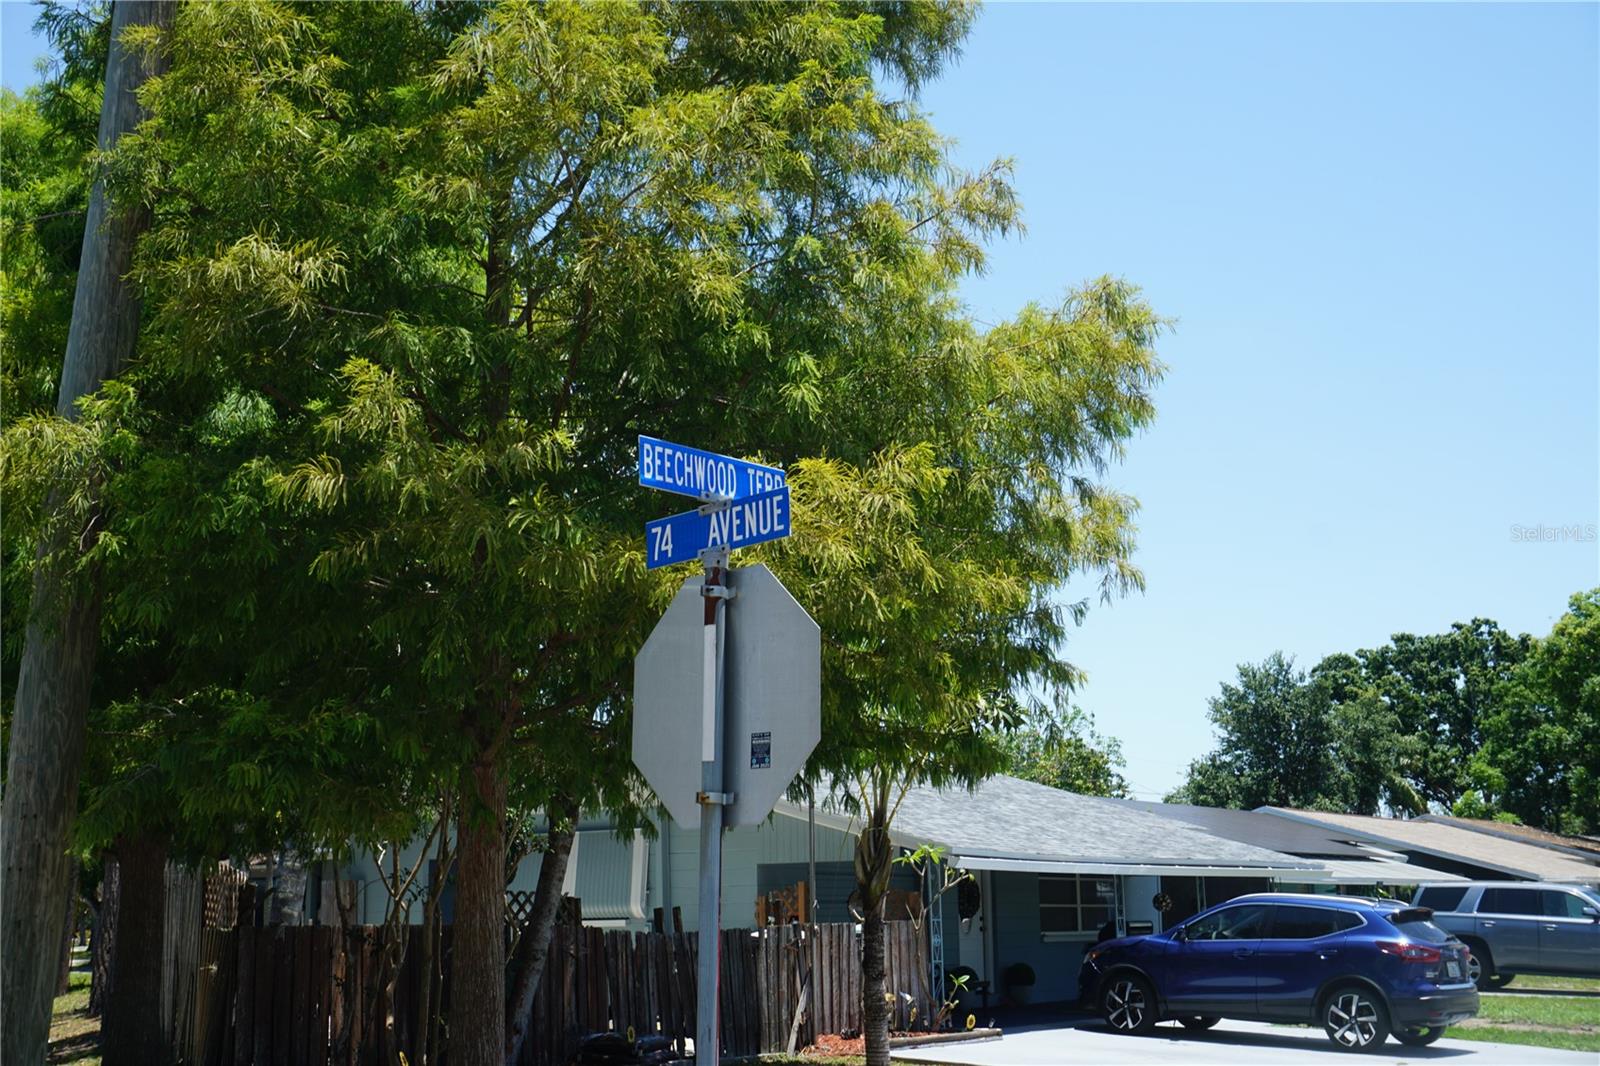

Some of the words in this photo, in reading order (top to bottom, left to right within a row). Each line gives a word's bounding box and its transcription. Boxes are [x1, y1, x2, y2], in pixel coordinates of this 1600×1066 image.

[643, 443, 737, 499] BEECHWOOD
[651, 523, 673, 561] 74
[708, 495, 785, 548] AVENUE
